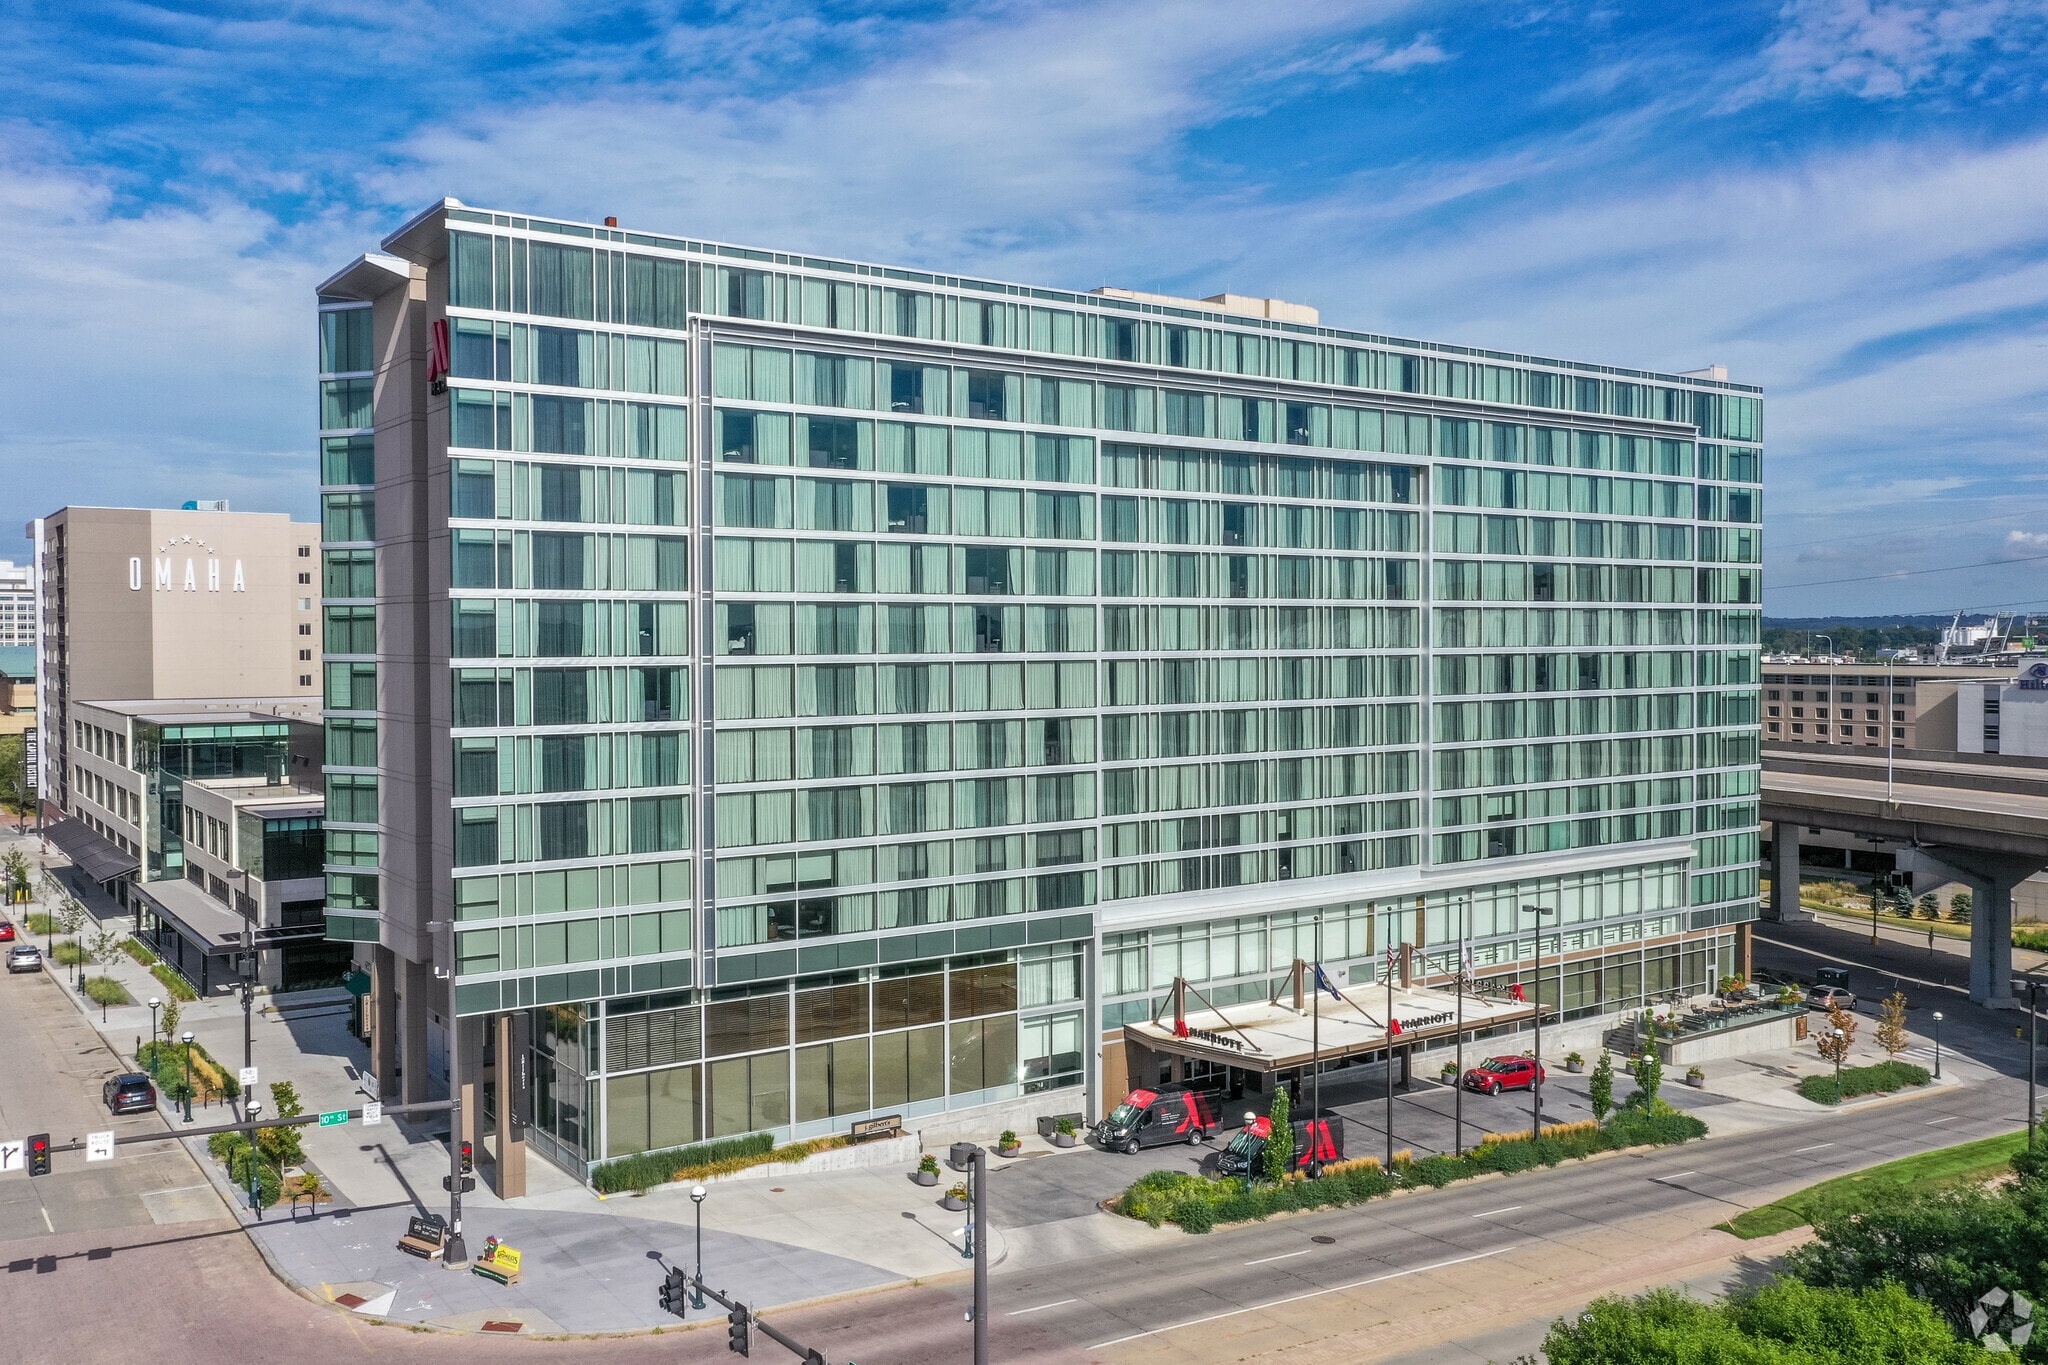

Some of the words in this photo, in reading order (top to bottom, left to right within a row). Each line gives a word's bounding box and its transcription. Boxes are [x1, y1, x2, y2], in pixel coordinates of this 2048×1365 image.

[129, 557, 245, 592] OMAHA
[26, 732, 37, 742] THE
[26, 742, 37, 764] CAPITOL
[26, 764, 38, 788] DISTRICT
[1401, 1011, 1454, 1030] MARRIOTT
[1189, 1027, 1243, 1052] MARRIOTT
[321, 1115, 335, 1125] 10th
[337, 1113, 346, 1122] St
